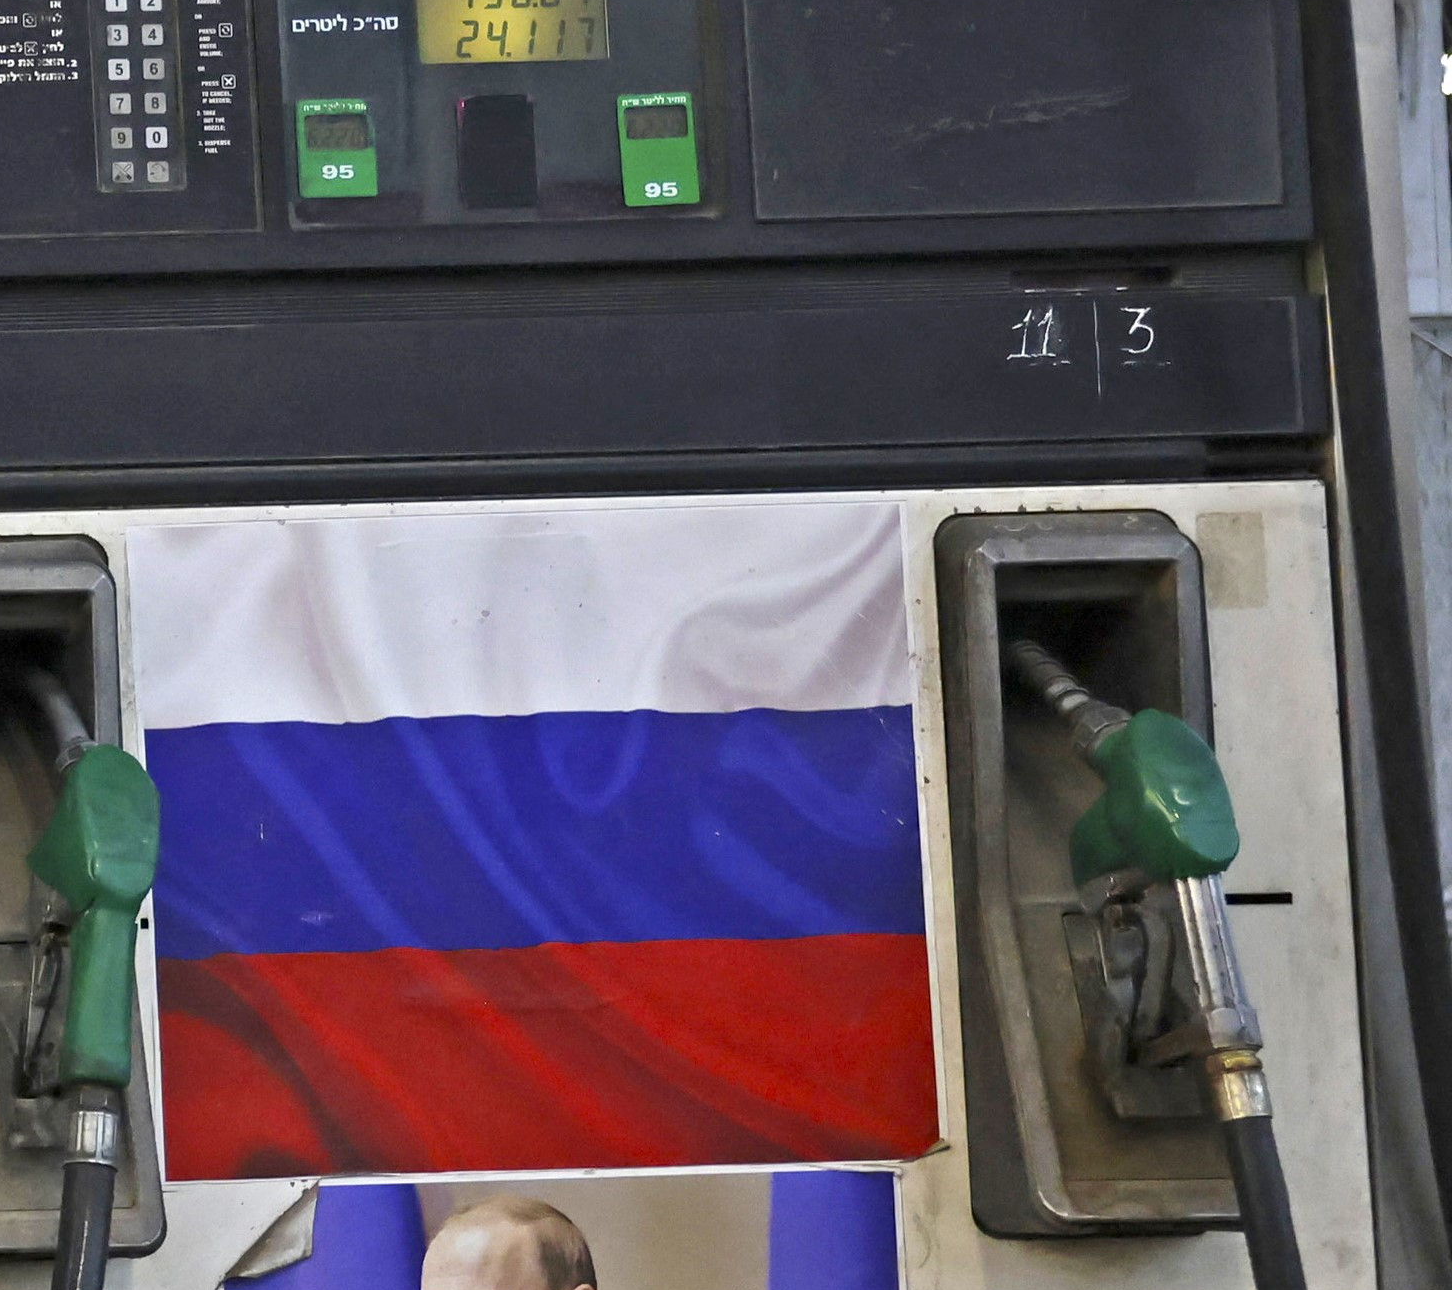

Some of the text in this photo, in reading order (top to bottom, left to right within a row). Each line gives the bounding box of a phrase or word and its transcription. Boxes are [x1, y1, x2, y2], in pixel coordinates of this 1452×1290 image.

[291, 13, 349, 33] ליטרים
[113, 29, 122, 41] 3
[148, 28, 157, 41] 4
[455, 16, 595, 59] 24.117
[115, 63, 124, 76] 5
[149, 63, 158, 75] 6
[116, 98, 124, 110] 7
[150, 97, 160, 110] 8
[117, 132, 126, 144] 9
[152, 132, 161, 144] 0
[321, 164, 355, 181] 95
[644, 182, 679, 198] 95
[1120, 306, 1156, 355] 3
